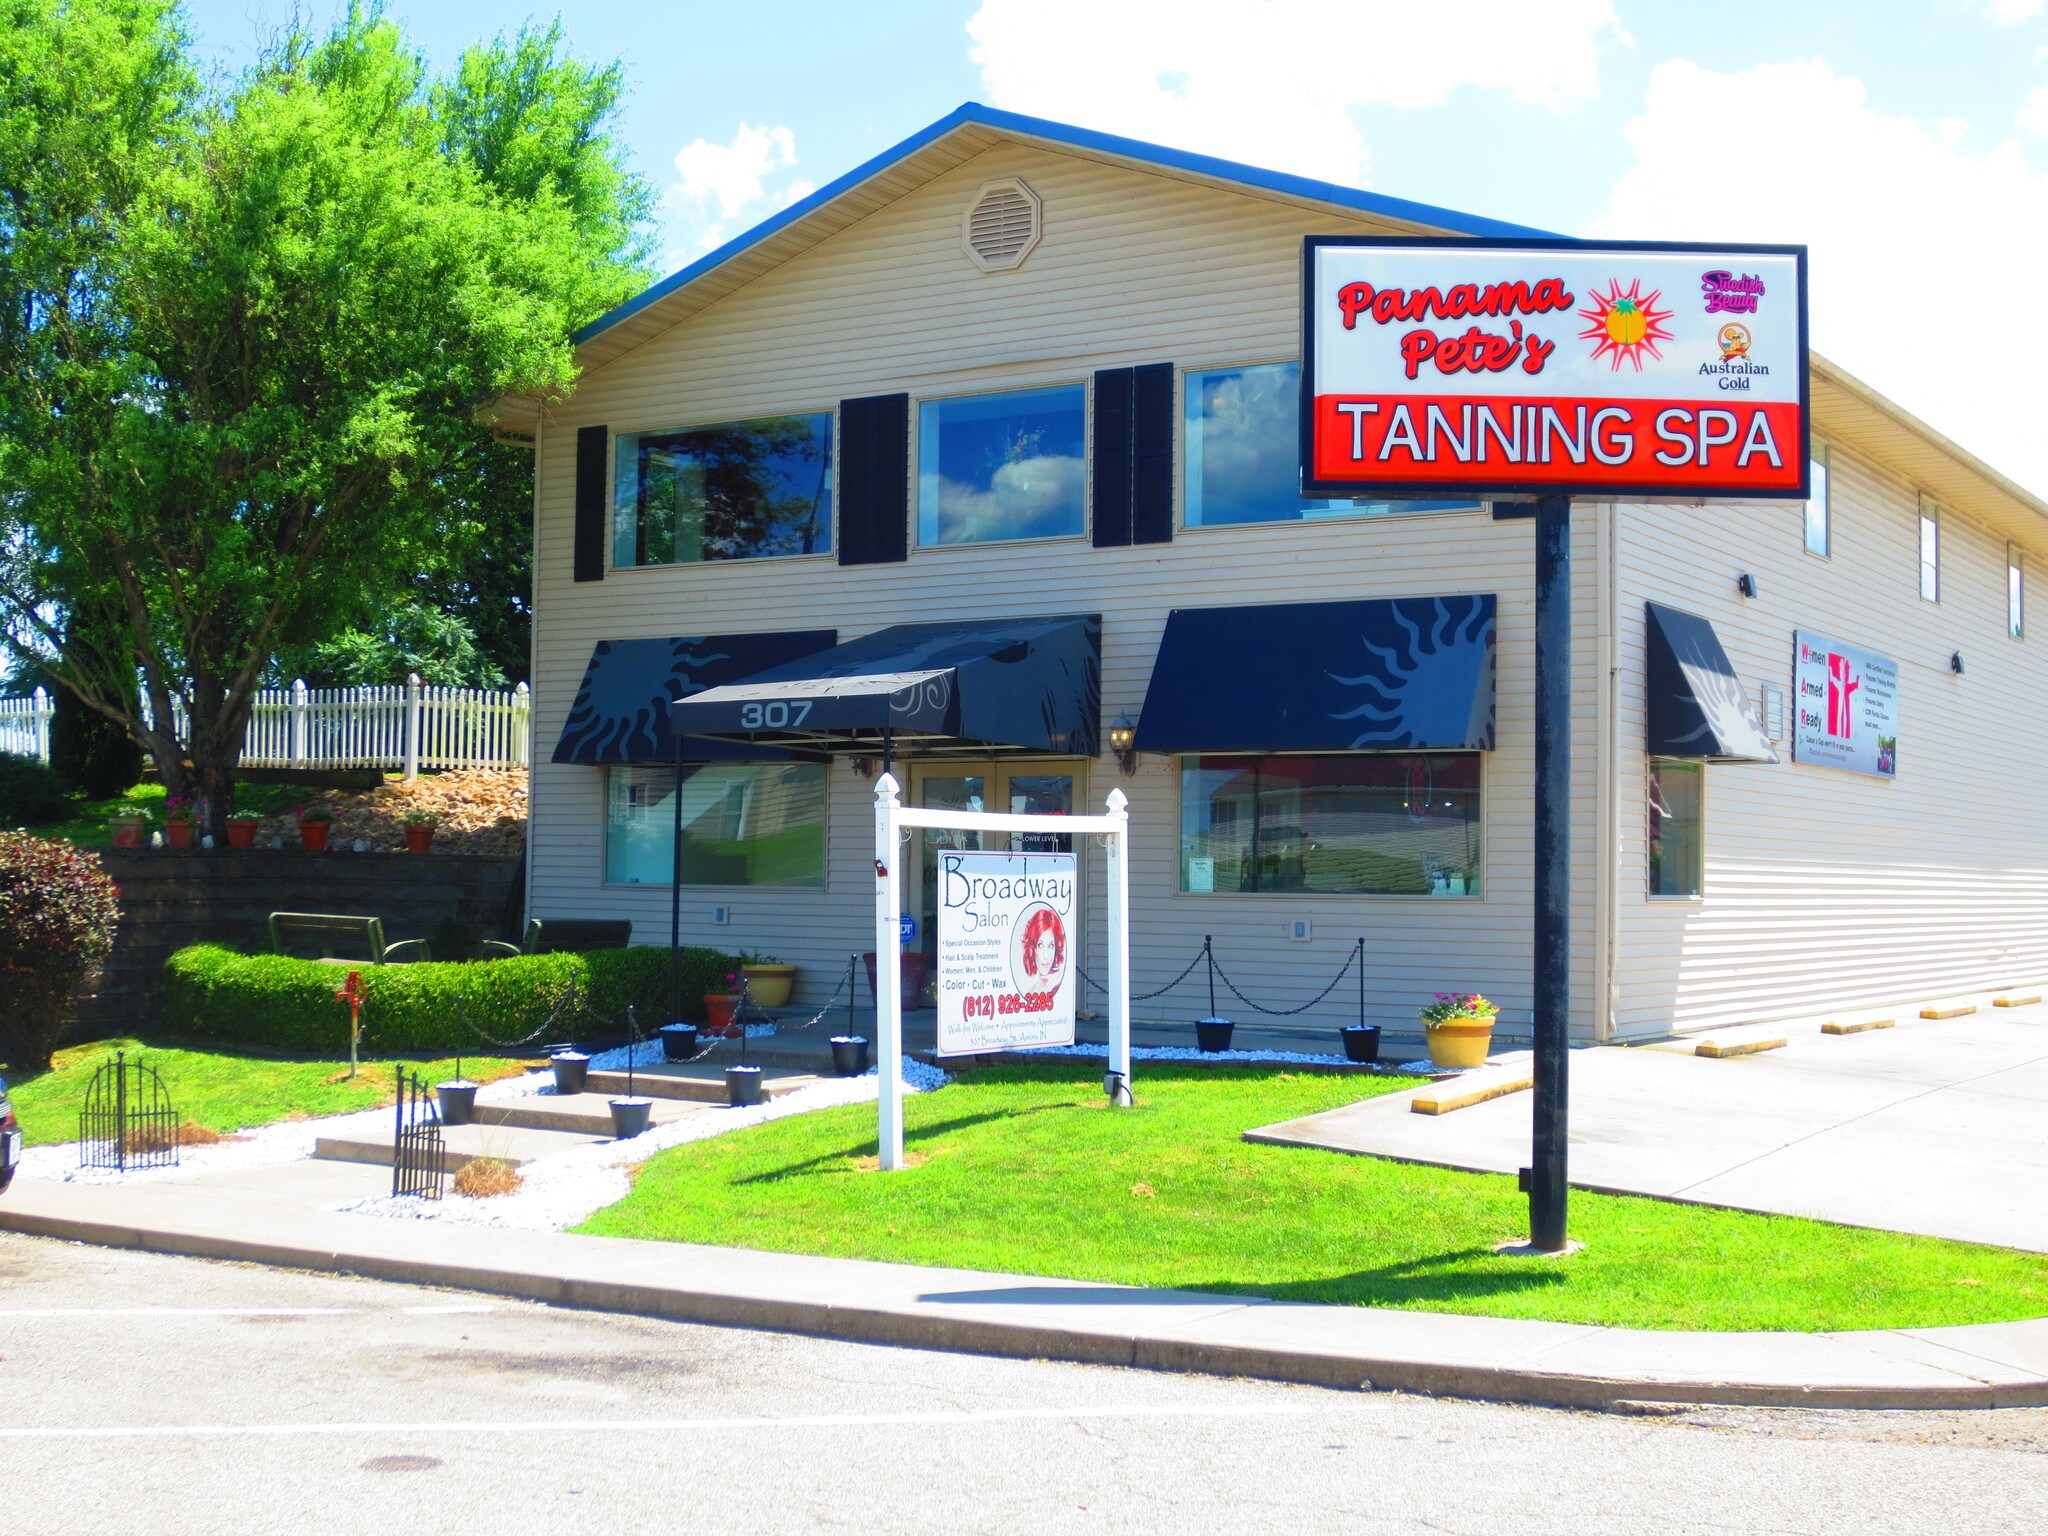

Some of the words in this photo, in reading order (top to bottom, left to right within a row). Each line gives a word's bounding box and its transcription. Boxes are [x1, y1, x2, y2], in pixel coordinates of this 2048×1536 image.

[1701, 270, 1765, 296] Swedish
[1338, 277, 1574, 330] Panama
[1703, 291, 1758, 314] Beauty
[1400, 320, 1556, 380] Pete's
[1698, 362, 1769, 376] Australian
[1718, 377, 1750, 390] Gold
[1337, 403, 1635, 466] TANNING
[1655, 408, 1784, 467] SPA
[1801, 678, 1823, 698] Armed
[741, 700, 813, 728] 307
[1801, 708, 1822, 732] Ready
[944, 856, 1072, 915] Broadway
[962, 902, 1009, 932] Salon
[900, 924, 912, 935] DT
[945, 939, 963, 947] Special
[987, 938, 1001, 946] Styles
[961, 953, 974, 961] Scalp
[982, 965, 1002, 973] Children
[945, 980, 966, 990] Color
[972, 979, 985, 990] Cut
[991, 978, 1007, 988] Wax
[962, 994, 995, 1022] (812)
[998, 991, 1054, 1015] 926-2285
[971, 1021, 995, 1033] Welcome
[1001, 1019, 1036, 1031] Appointments
[1037, 1015, 1067, 1028] Appreciated
[981, 1035, 1008, 1046] Broadway
